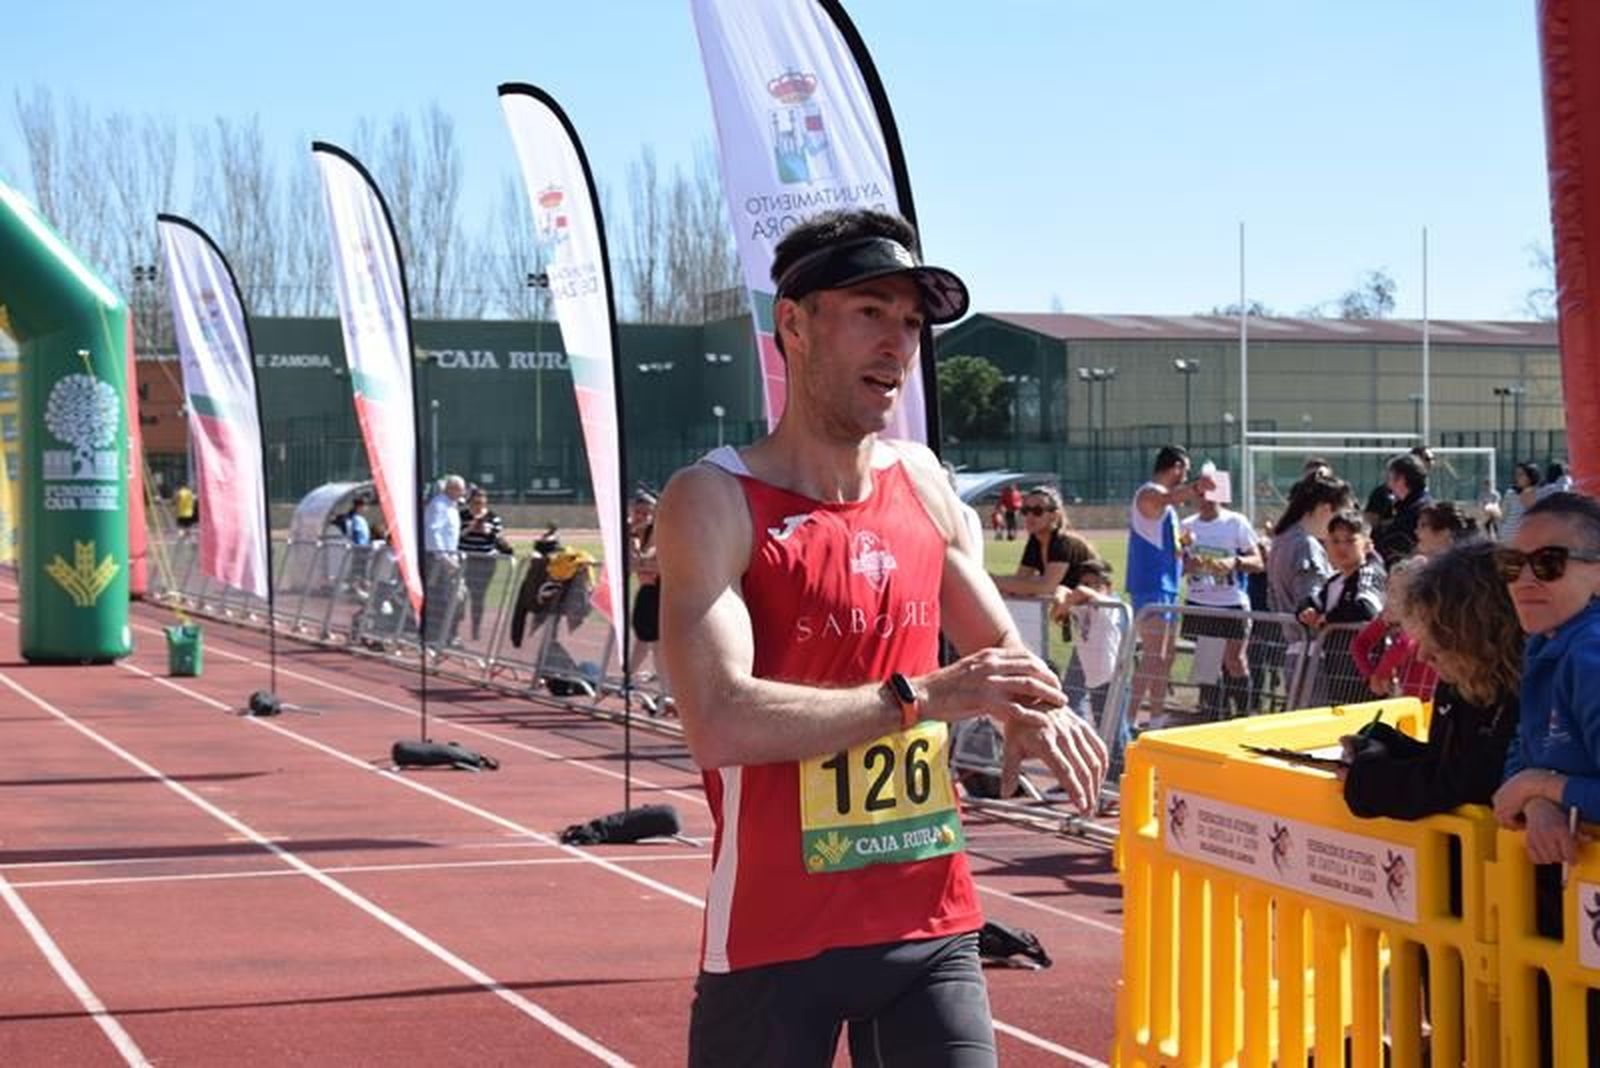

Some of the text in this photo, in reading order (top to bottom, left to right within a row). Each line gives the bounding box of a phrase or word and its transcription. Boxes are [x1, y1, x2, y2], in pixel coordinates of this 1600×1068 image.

[269, 353, 332, 369] ZAMORA
[437, 349, 569, 370] CAJA RUR
[796, 600, 931, 642] SABORE
[821, 738, 931, 815] 126
[855, 825, 943, 855] CAJA RURA
